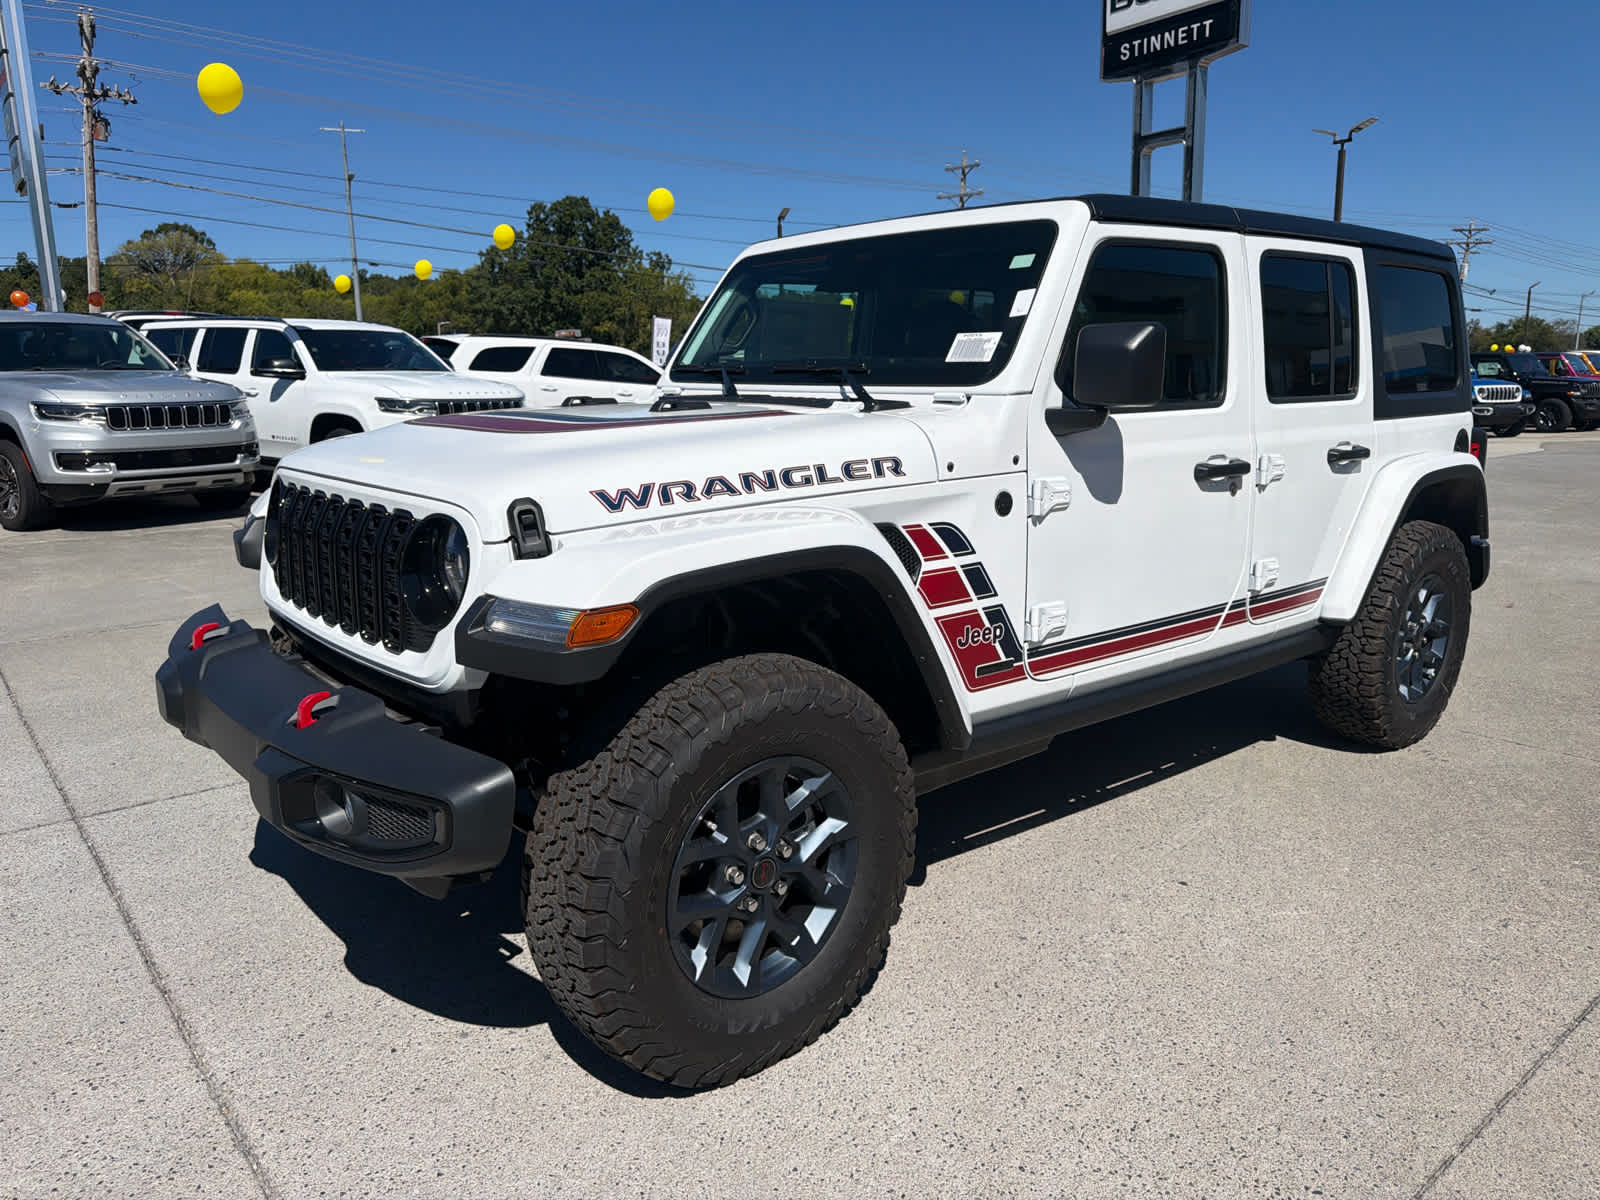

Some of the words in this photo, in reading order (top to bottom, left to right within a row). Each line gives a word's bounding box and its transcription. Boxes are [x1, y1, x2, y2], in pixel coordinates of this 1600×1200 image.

[1120, 19, 1214, 61] STINNETT
[589, 456, 907, 513] WRANGLER
[956, 622, 1005, 649] Jeep
